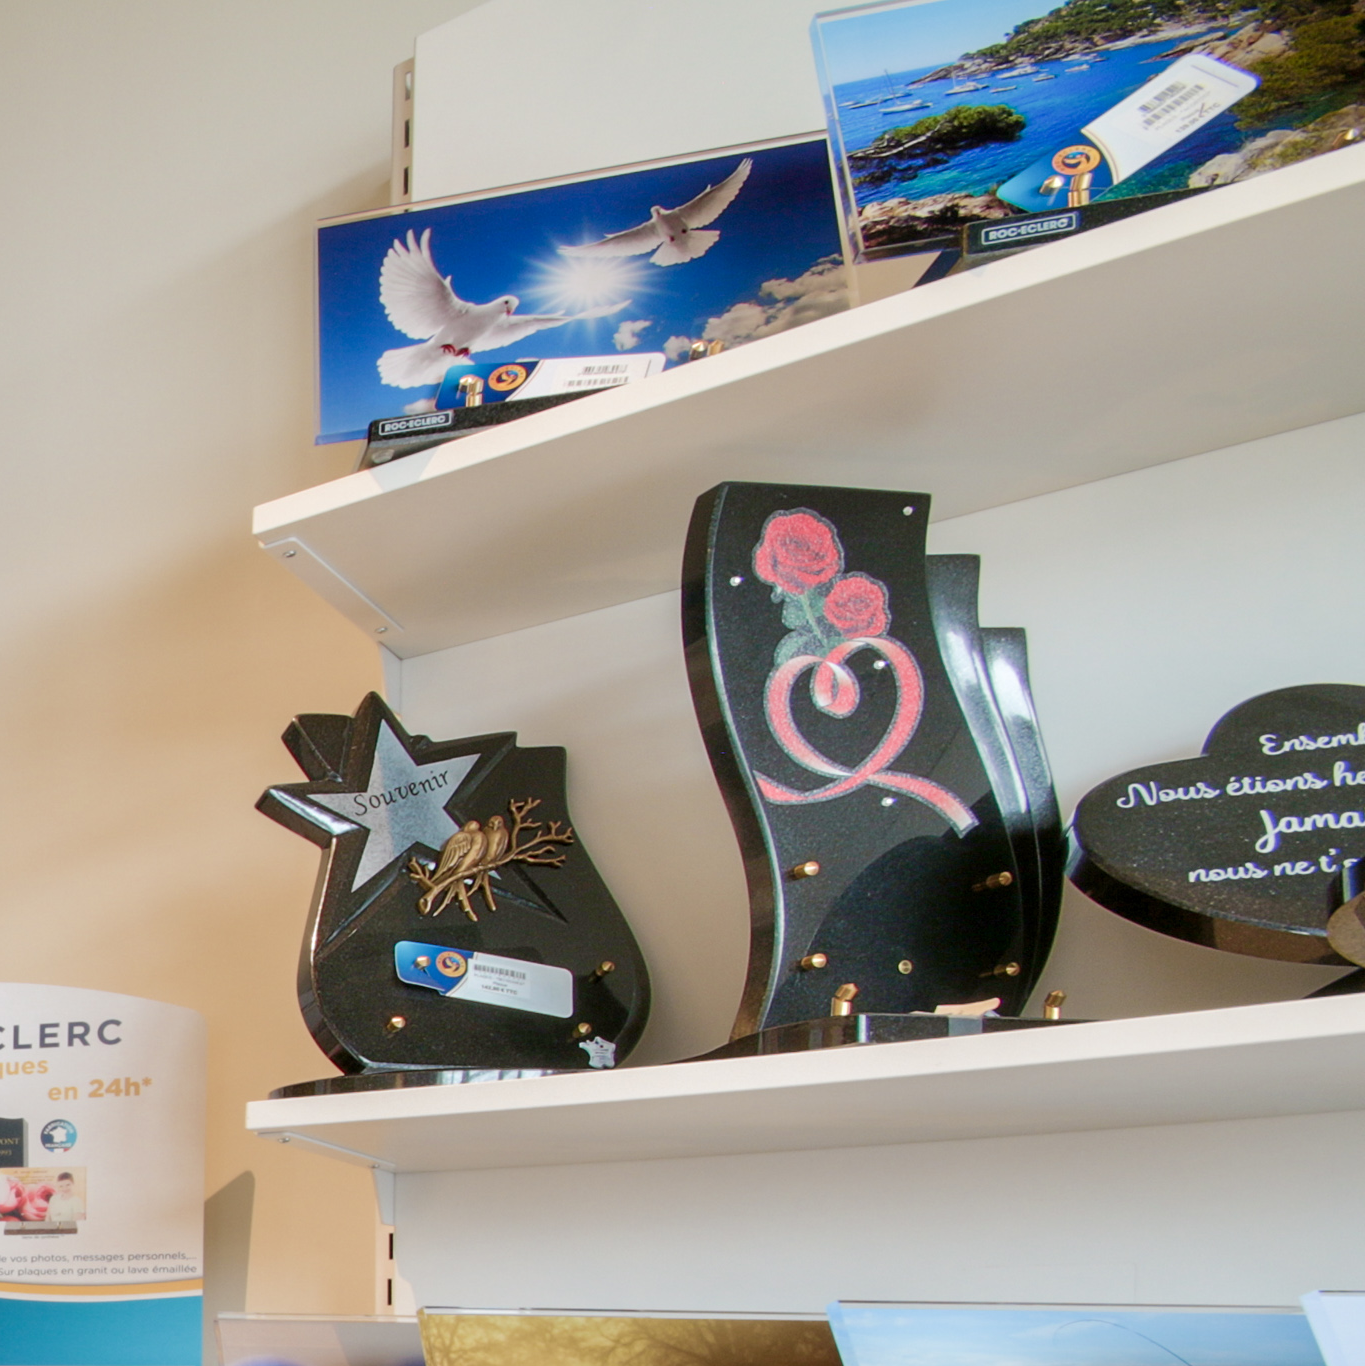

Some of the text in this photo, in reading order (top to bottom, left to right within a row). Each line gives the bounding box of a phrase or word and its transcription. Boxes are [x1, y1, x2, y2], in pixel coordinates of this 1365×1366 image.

[353, 769, 449, 816] Souvenir
[1117, 781, 1222, 808] Nous
[1226, 772, 1329, 796] étions
[1255, 809, 1365, 853] Jama
[1188, 862, 1268, 882] nous
[1274, 860, 1316, 876] ne
[48, 1087, 77, 1100] en
[31, 1255, 69, 1263] photos,
[18, 1268, 58, 1276] plaques
[77, 1267, 107, 1276] granit
[152, 1265, 197, 1273] émaillée
